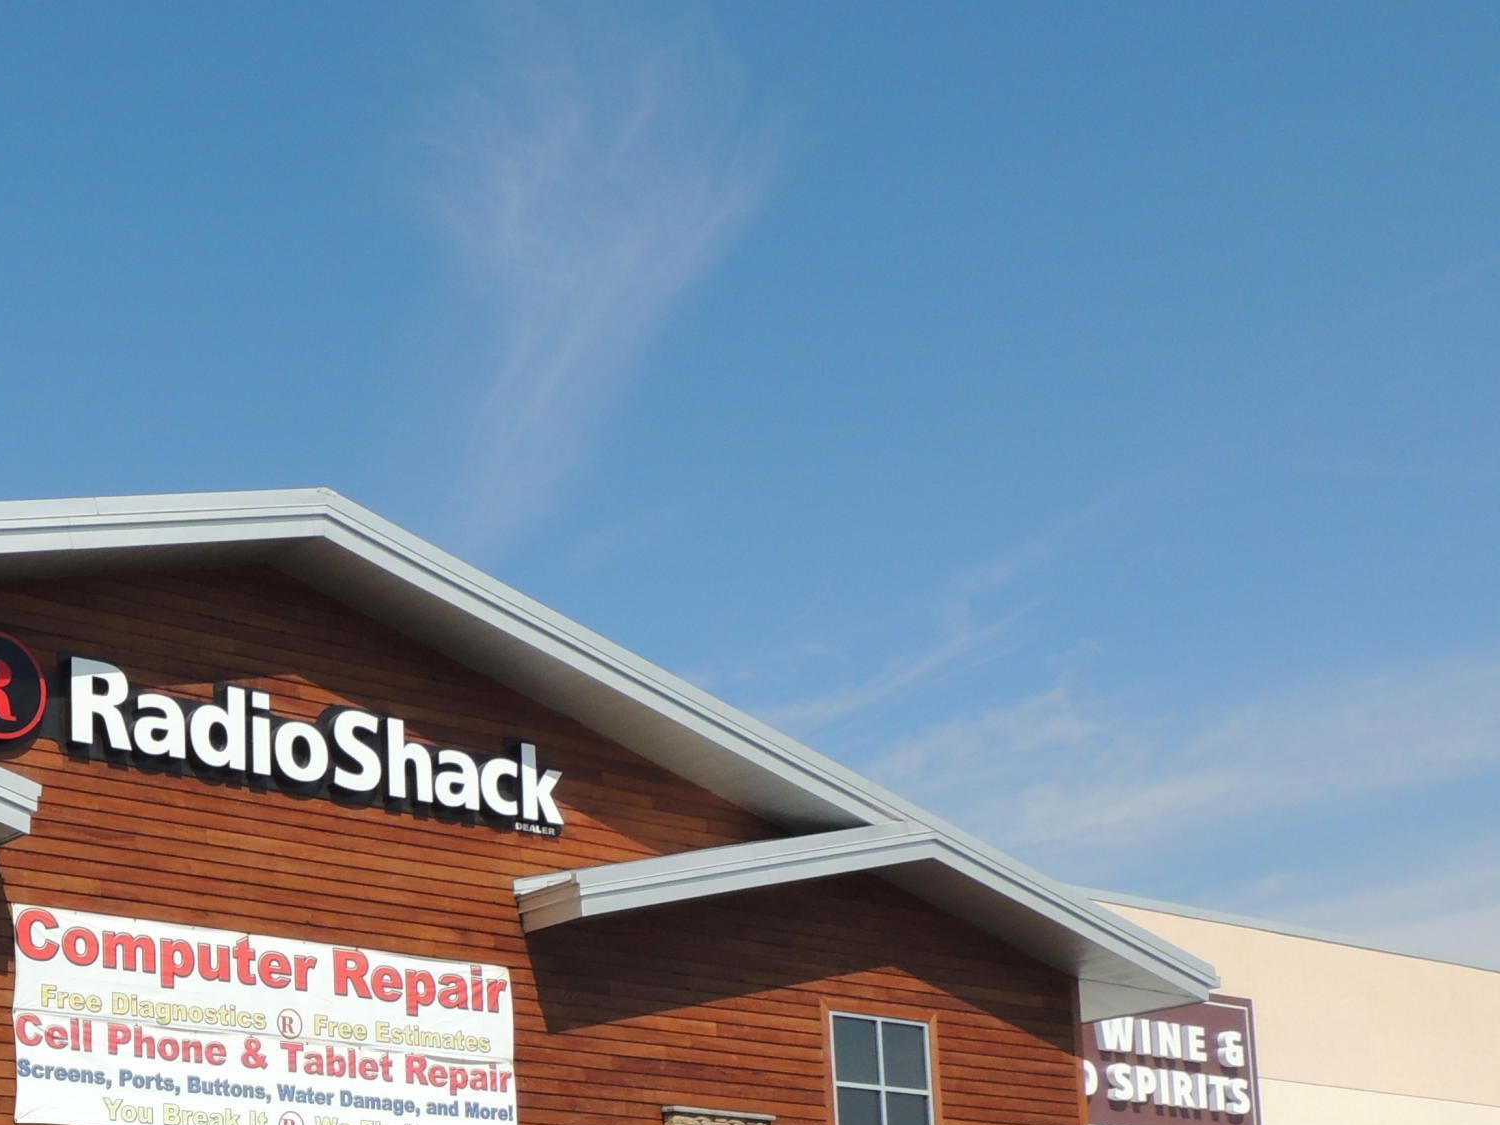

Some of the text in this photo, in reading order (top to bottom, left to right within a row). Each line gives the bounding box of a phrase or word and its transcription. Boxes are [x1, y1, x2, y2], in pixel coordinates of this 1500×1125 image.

[70, 655, 565, 825] RadioShack
[515, 821, 557, 836] DEALER
[15, 907, 507, 1017] Computer Repair
[40, 983, 102, 1013] Free
[111, 991, 267, 1030] Diagnostics
[313, 1014, 368, 1040] Free
[374, 1021, 492, 1053] Estimates
[1094, 1016, 1245, 1068] WINE &
[15, 1012, 513, 1096] Cell Phone & Tablet Repair
[17, 1057, 514, 1122] Screens, Ports, Buttons, Water Damage, and More!
[103, 1096, 155, 1125] You
[1106, 1062, 1251, 1115] SPIRITS
